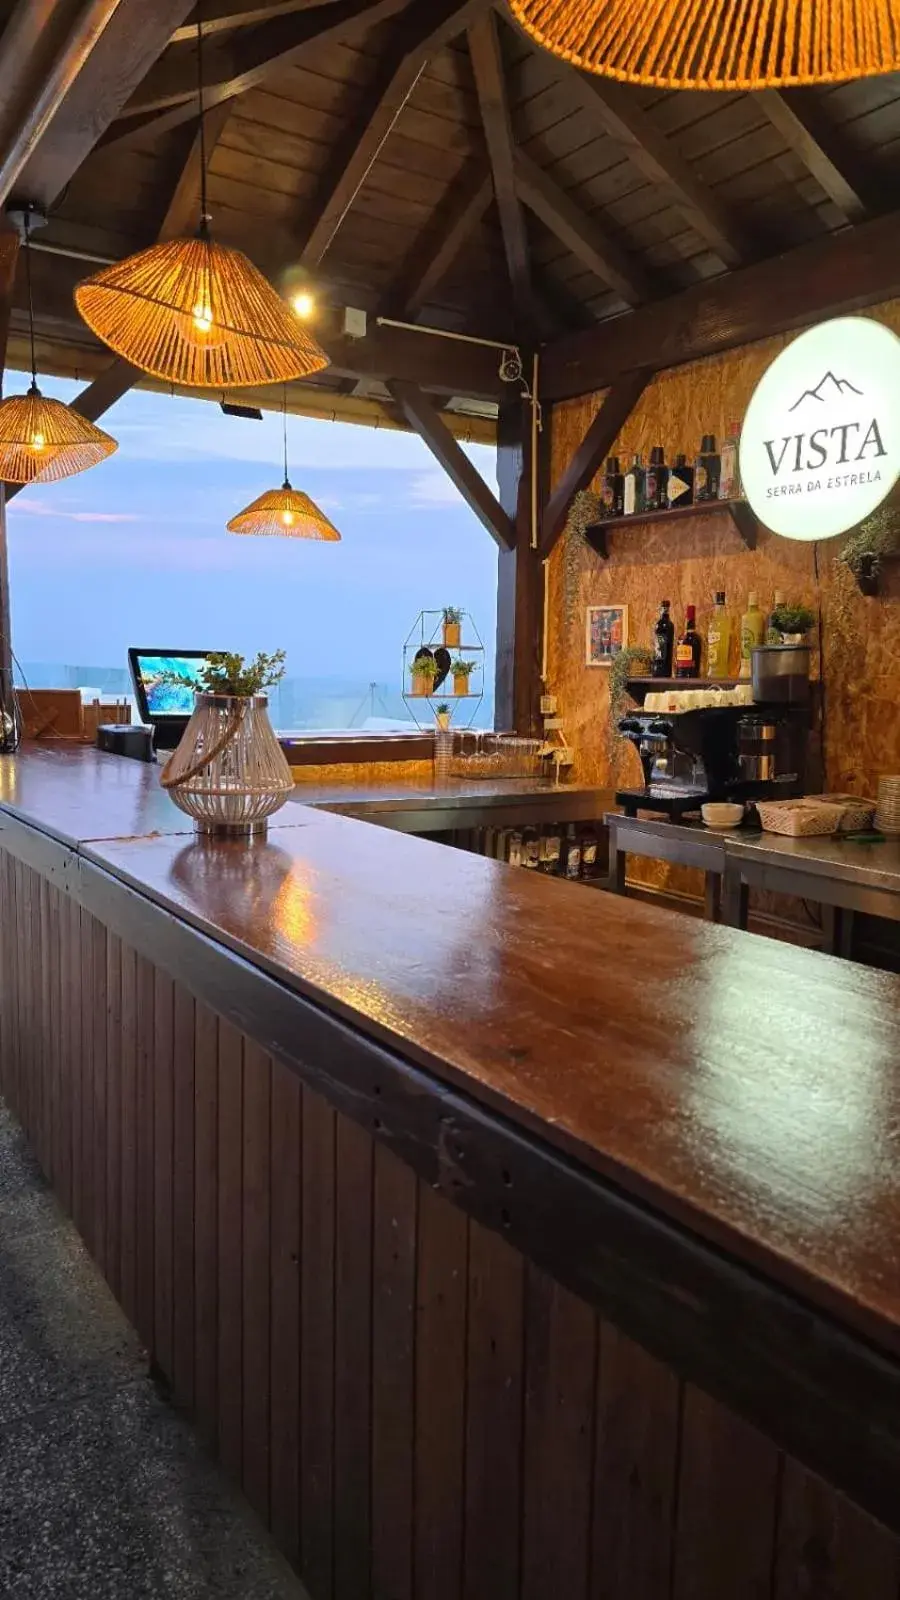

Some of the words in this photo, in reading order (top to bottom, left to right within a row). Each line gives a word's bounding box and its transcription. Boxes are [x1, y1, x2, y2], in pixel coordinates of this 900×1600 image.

[763, 418, 888, 476] VISTA
[766, 484, 802, 498] SERRA
[807, 480, 821, 492] DA
[827, 470, 881, 489] ESTRELA
